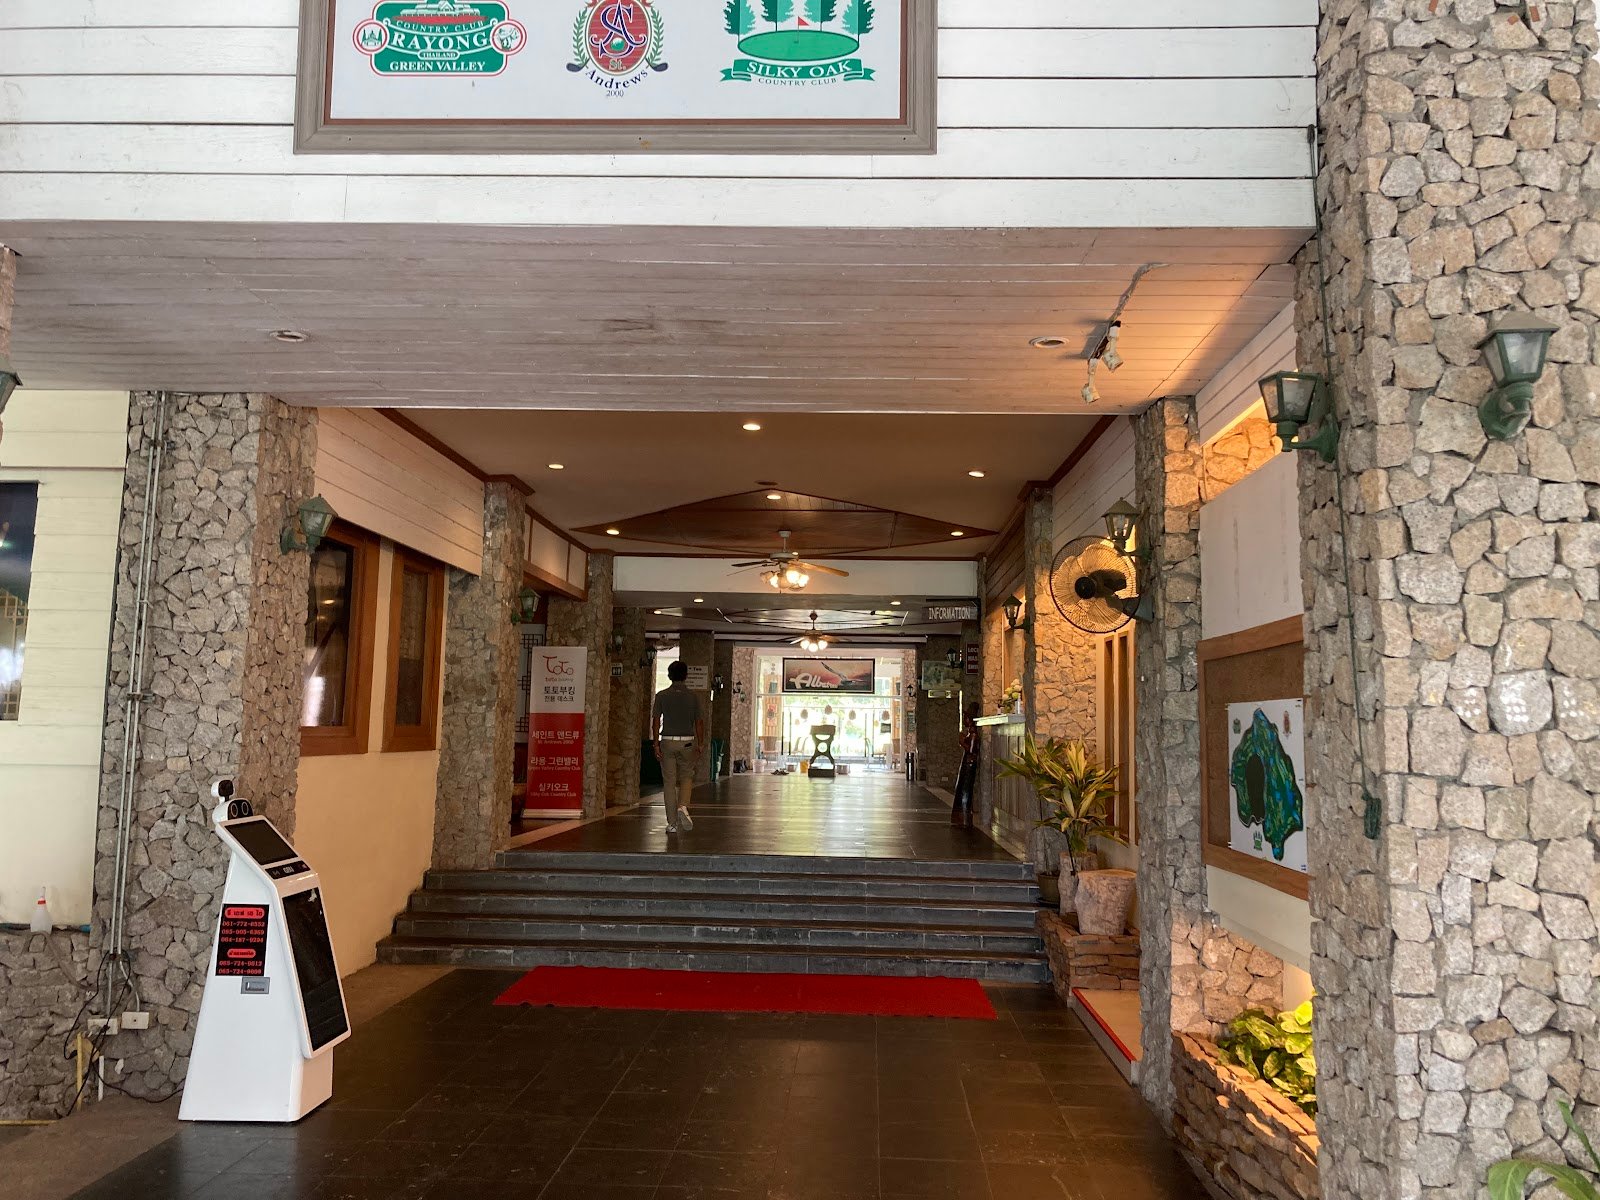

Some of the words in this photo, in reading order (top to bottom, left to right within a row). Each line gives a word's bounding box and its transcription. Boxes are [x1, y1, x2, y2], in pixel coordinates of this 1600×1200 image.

[396, 20, 448, 34] COUNTRY
[454, 20, 485, 33] CLUB
[391, 32, 488, 51] RAYONG
[422, 51, 457, 59] THAILAND
[389, 61, 438, 72] GREEN
[440, 61, 486, 72] VALLEY
[608, 58, 627, 71] St.
[746, 60, 801, 79] SILKY
[809, 60, 853, 77] OAK
[585, 69, 649, 90] Andrews
[758, 77, 807, 87] COUNTRY
[811, 77, 838, 86] CLUB
[605, 89, 625, 98] 2000
[928, 607, 971, 620] INFORMATION
[544, 686, 576, 696] 토토부킹
